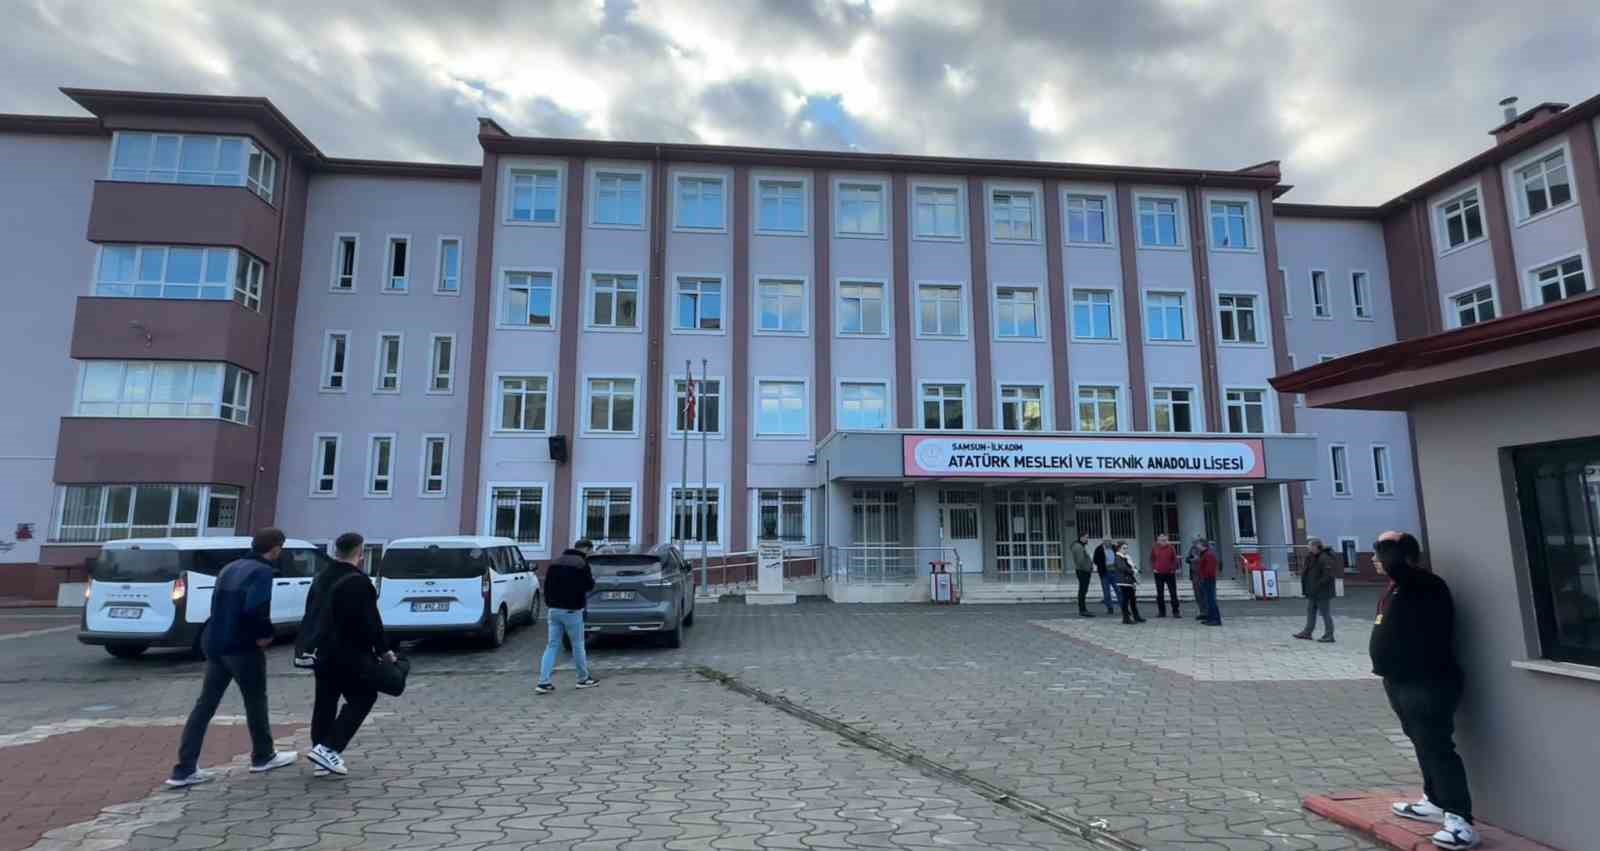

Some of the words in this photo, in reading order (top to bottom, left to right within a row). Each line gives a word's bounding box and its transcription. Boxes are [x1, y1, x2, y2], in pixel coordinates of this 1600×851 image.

[949, 453, 1010, 468] ATATÜRK
[1014, 454, 1073, 468] MESLEKİ
[1075, 456, 1092, 468] VE
[1095, 454, 1143, 469] TEKNİK
[1147, 456, 1200, 470] ANADOLU
[1203, 456, 1244, 470] LİSESİ
